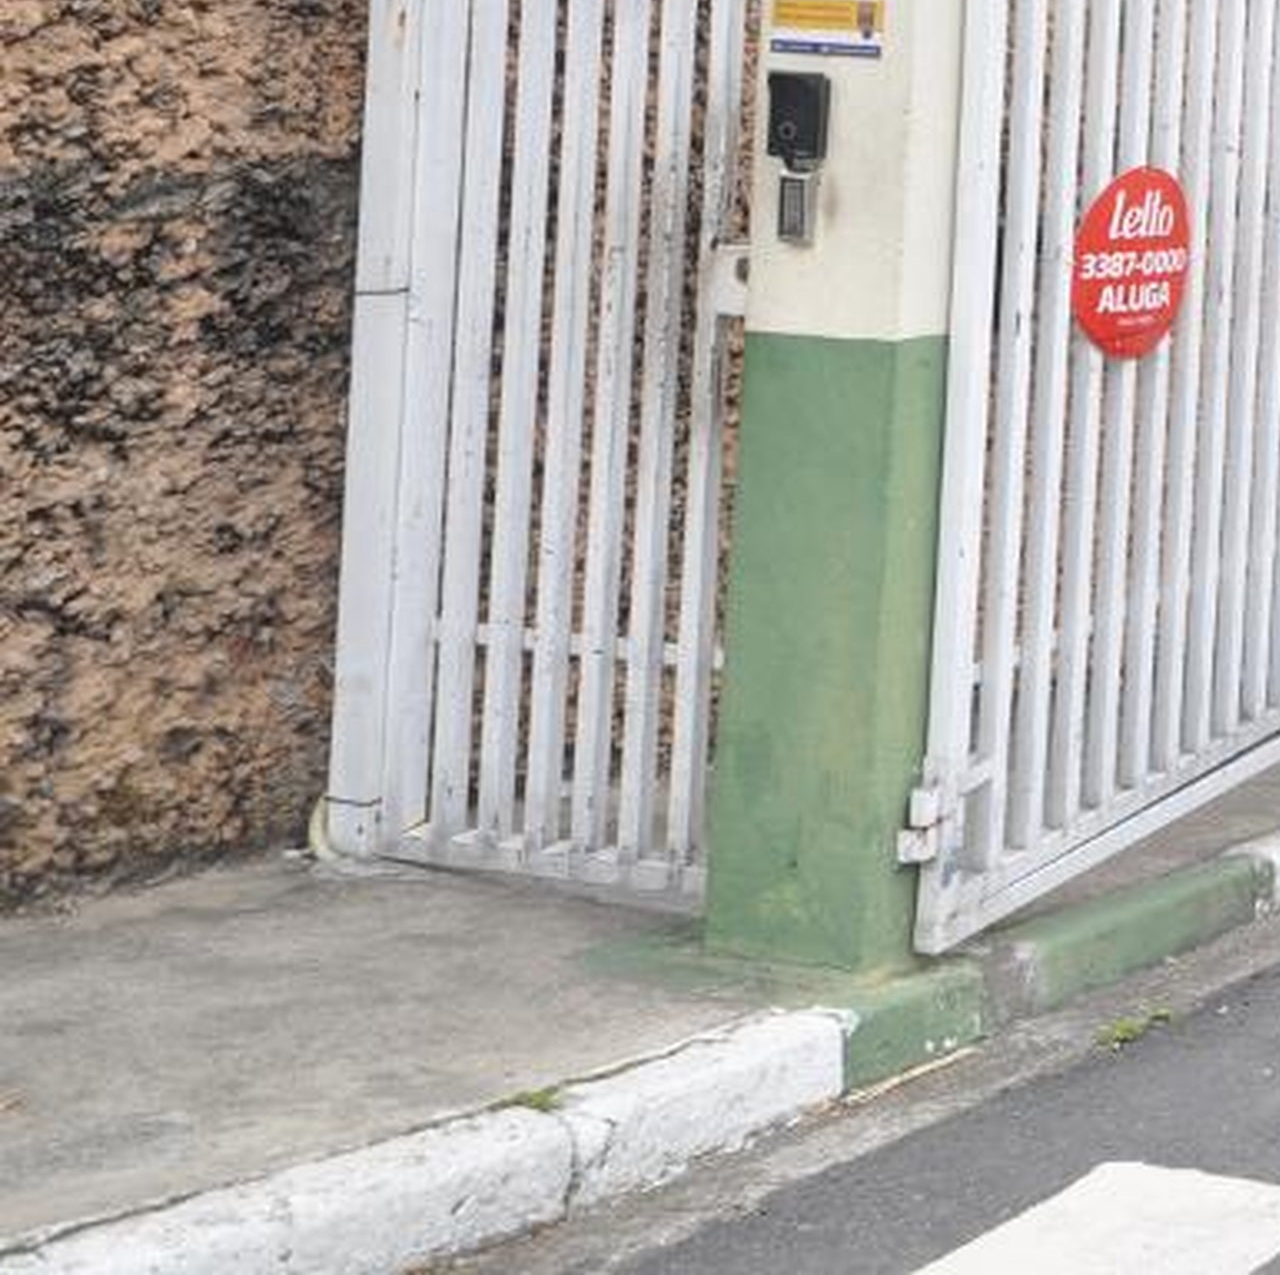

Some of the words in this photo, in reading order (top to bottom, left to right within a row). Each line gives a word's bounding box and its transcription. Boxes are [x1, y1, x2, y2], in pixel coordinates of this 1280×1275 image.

[1108, 189, 1175, 240] Lello
[1079, 247, 1187, 280] 3387-0000
[1096, 281, 1171, 313] ALUGA
